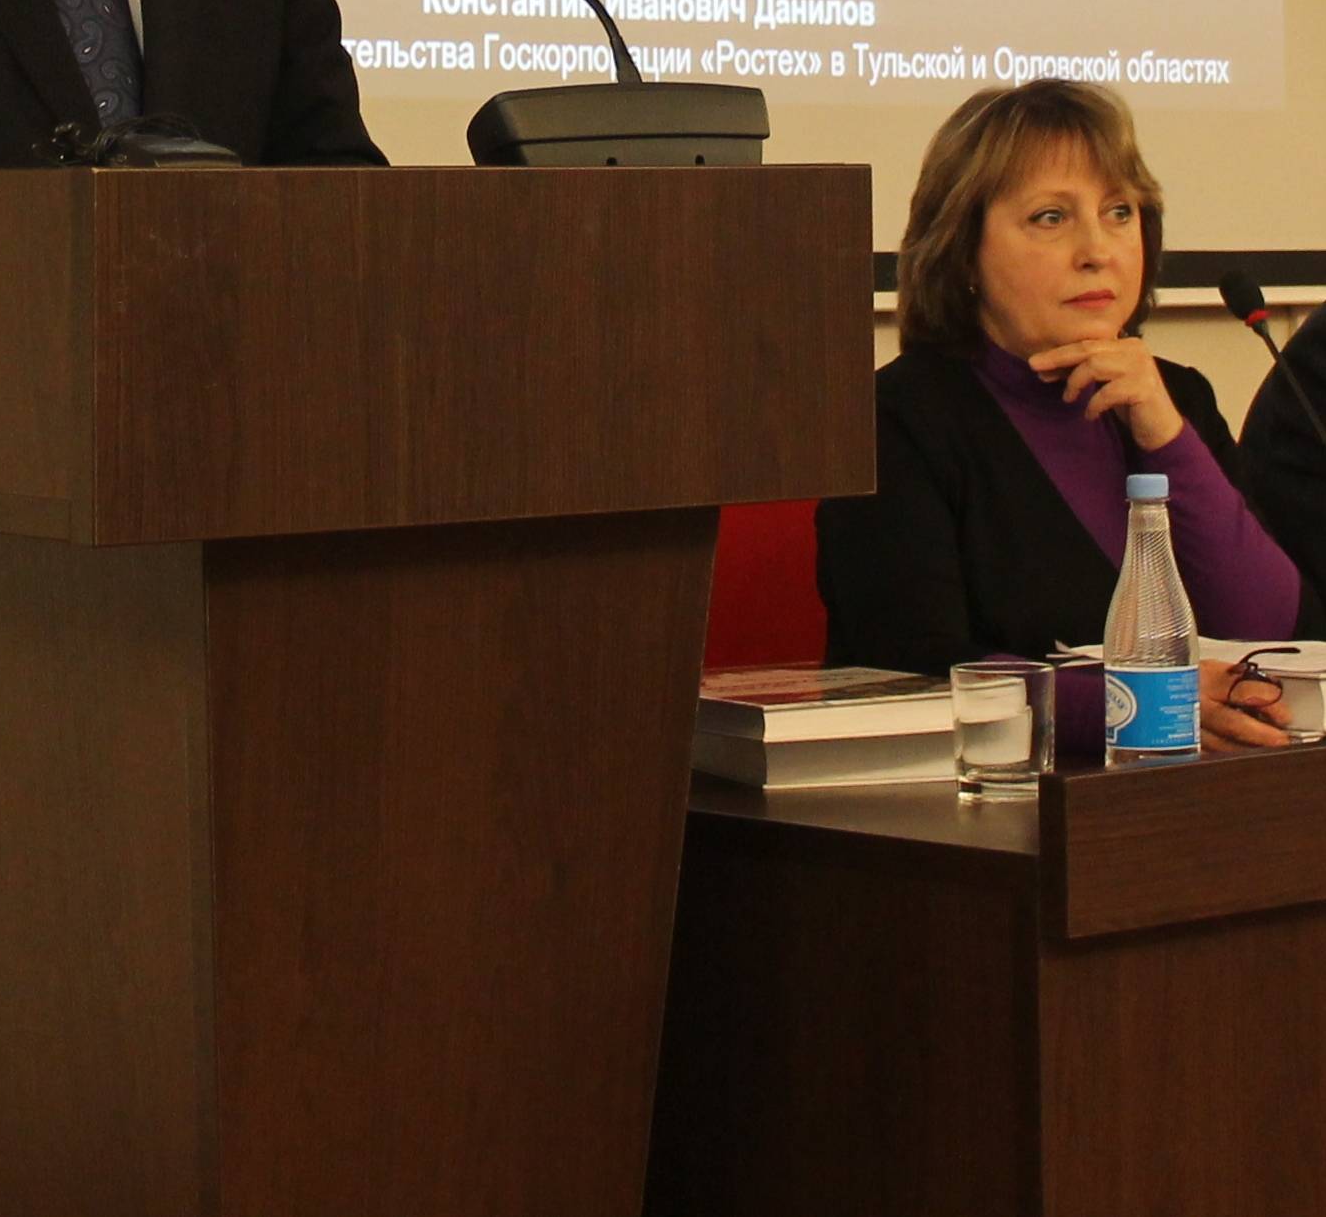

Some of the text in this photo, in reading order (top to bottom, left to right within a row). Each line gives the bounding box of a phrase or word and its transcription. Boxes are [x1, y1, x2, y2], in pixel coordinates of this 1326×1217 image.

[700, 39, 822, 77] «Ростех»
[831, 50, 846, 77] в
[853, 42, 965, 87] Тульской
[972, 55, 987, 80] и
[993, 46, 1121, 87] Орловской
[1126, 50, 1230, 84] областях
